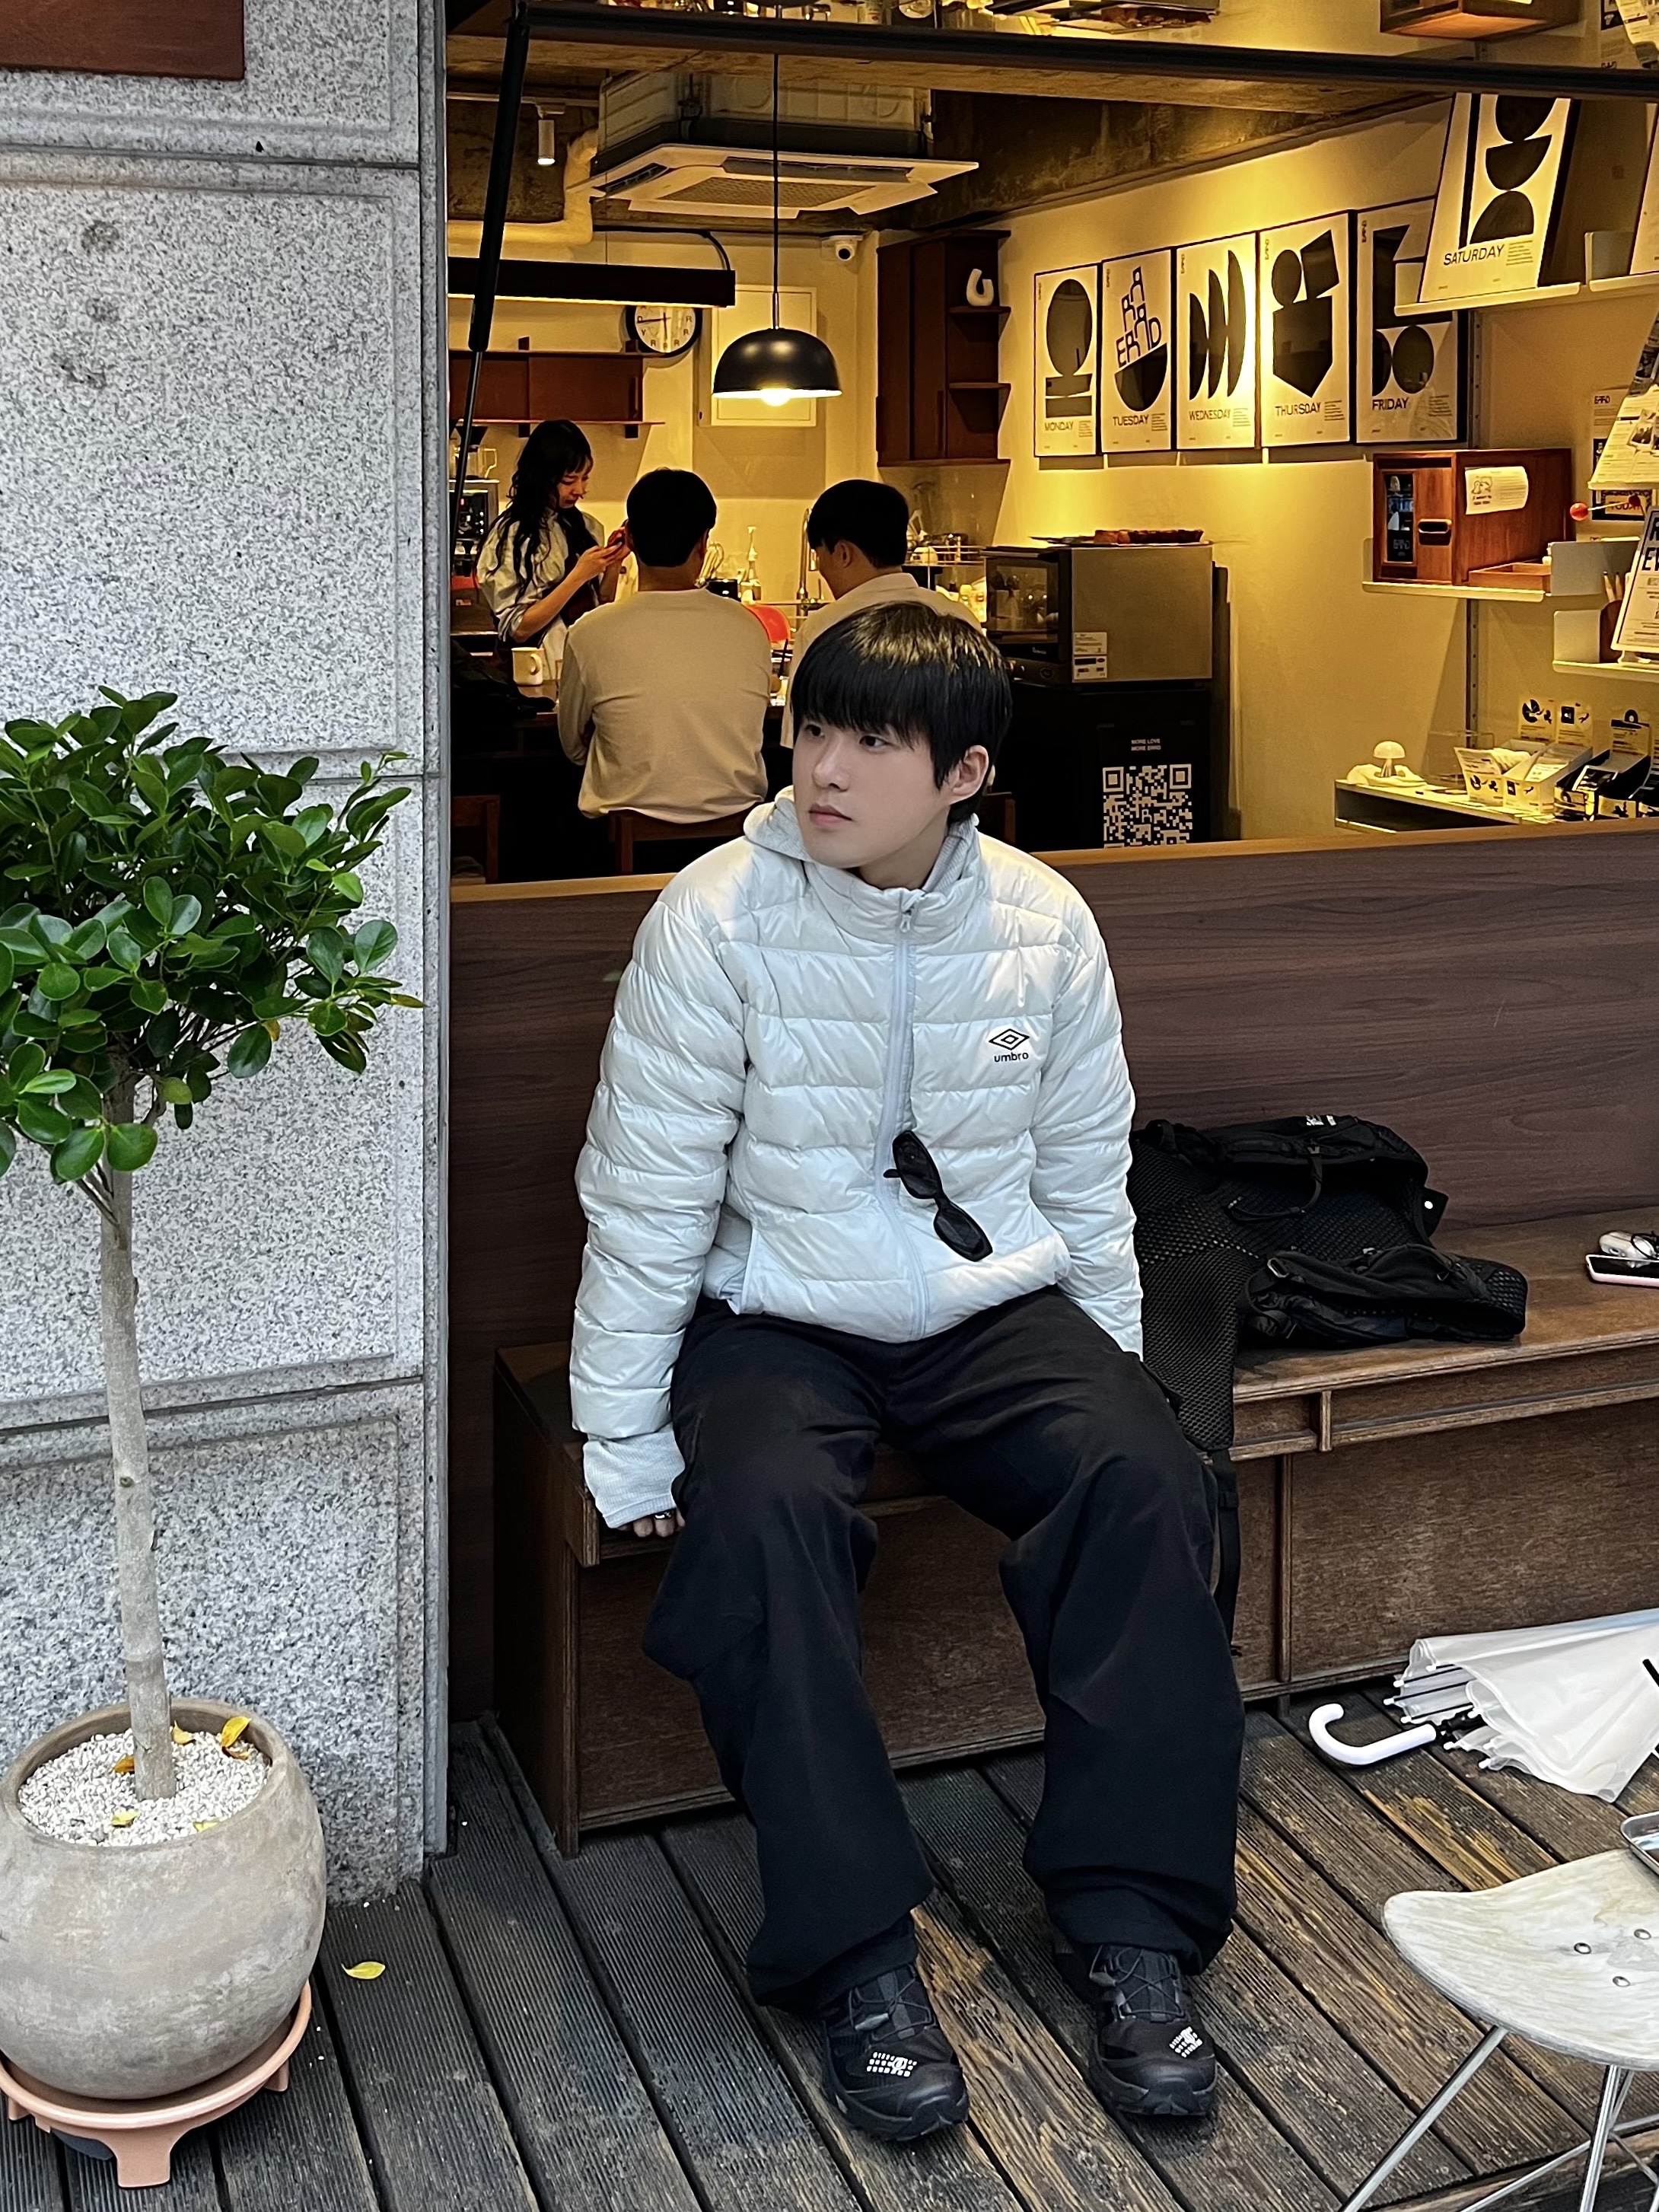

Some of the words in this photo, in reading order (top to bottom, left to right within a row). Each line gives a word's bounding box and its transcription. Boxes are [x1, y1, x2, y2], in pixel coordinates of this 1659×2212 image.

[1444, 244, 1505, 266] SATURDAY
[1275, 402, 1320, 416] THURSDAY
[1372, 397, 1408, 410] FRIDAY
[1113, 414, 1149, 426] TUESDAY
[1189, 409, 1231, 421] WEDNESDAY
[1044, 421, 1074, 432] MONDAY
[994, 1052, 1029, 1063] umbro
